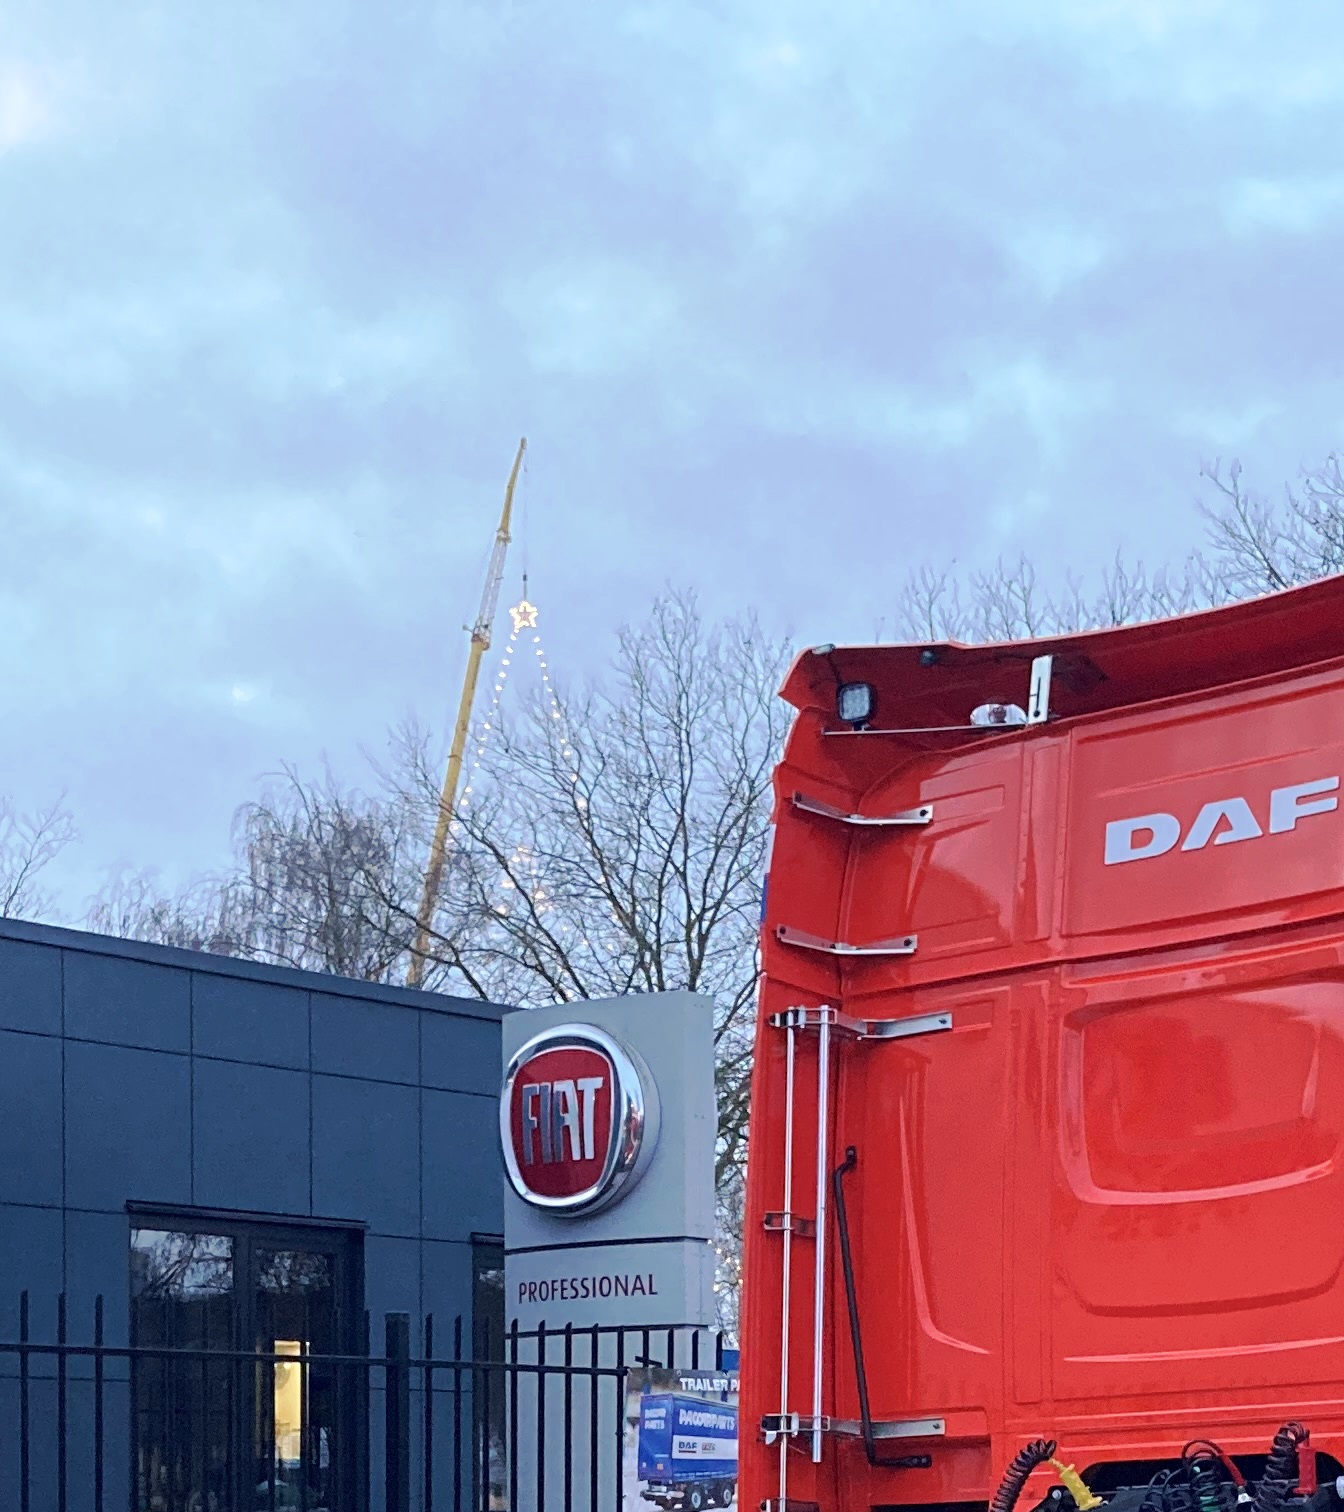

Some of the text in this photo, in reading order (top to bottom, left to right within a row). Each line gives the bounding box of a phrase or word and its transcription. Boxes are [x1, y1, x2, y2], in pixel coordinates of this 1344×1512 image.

[1103, 775, 1340, 866] DAF
[521, 1075, 604, 1166] FIAT
[518, 1273, 658, 1305] PROFESSIONAL
[679, 1377, 728, 1391] TRAILER
